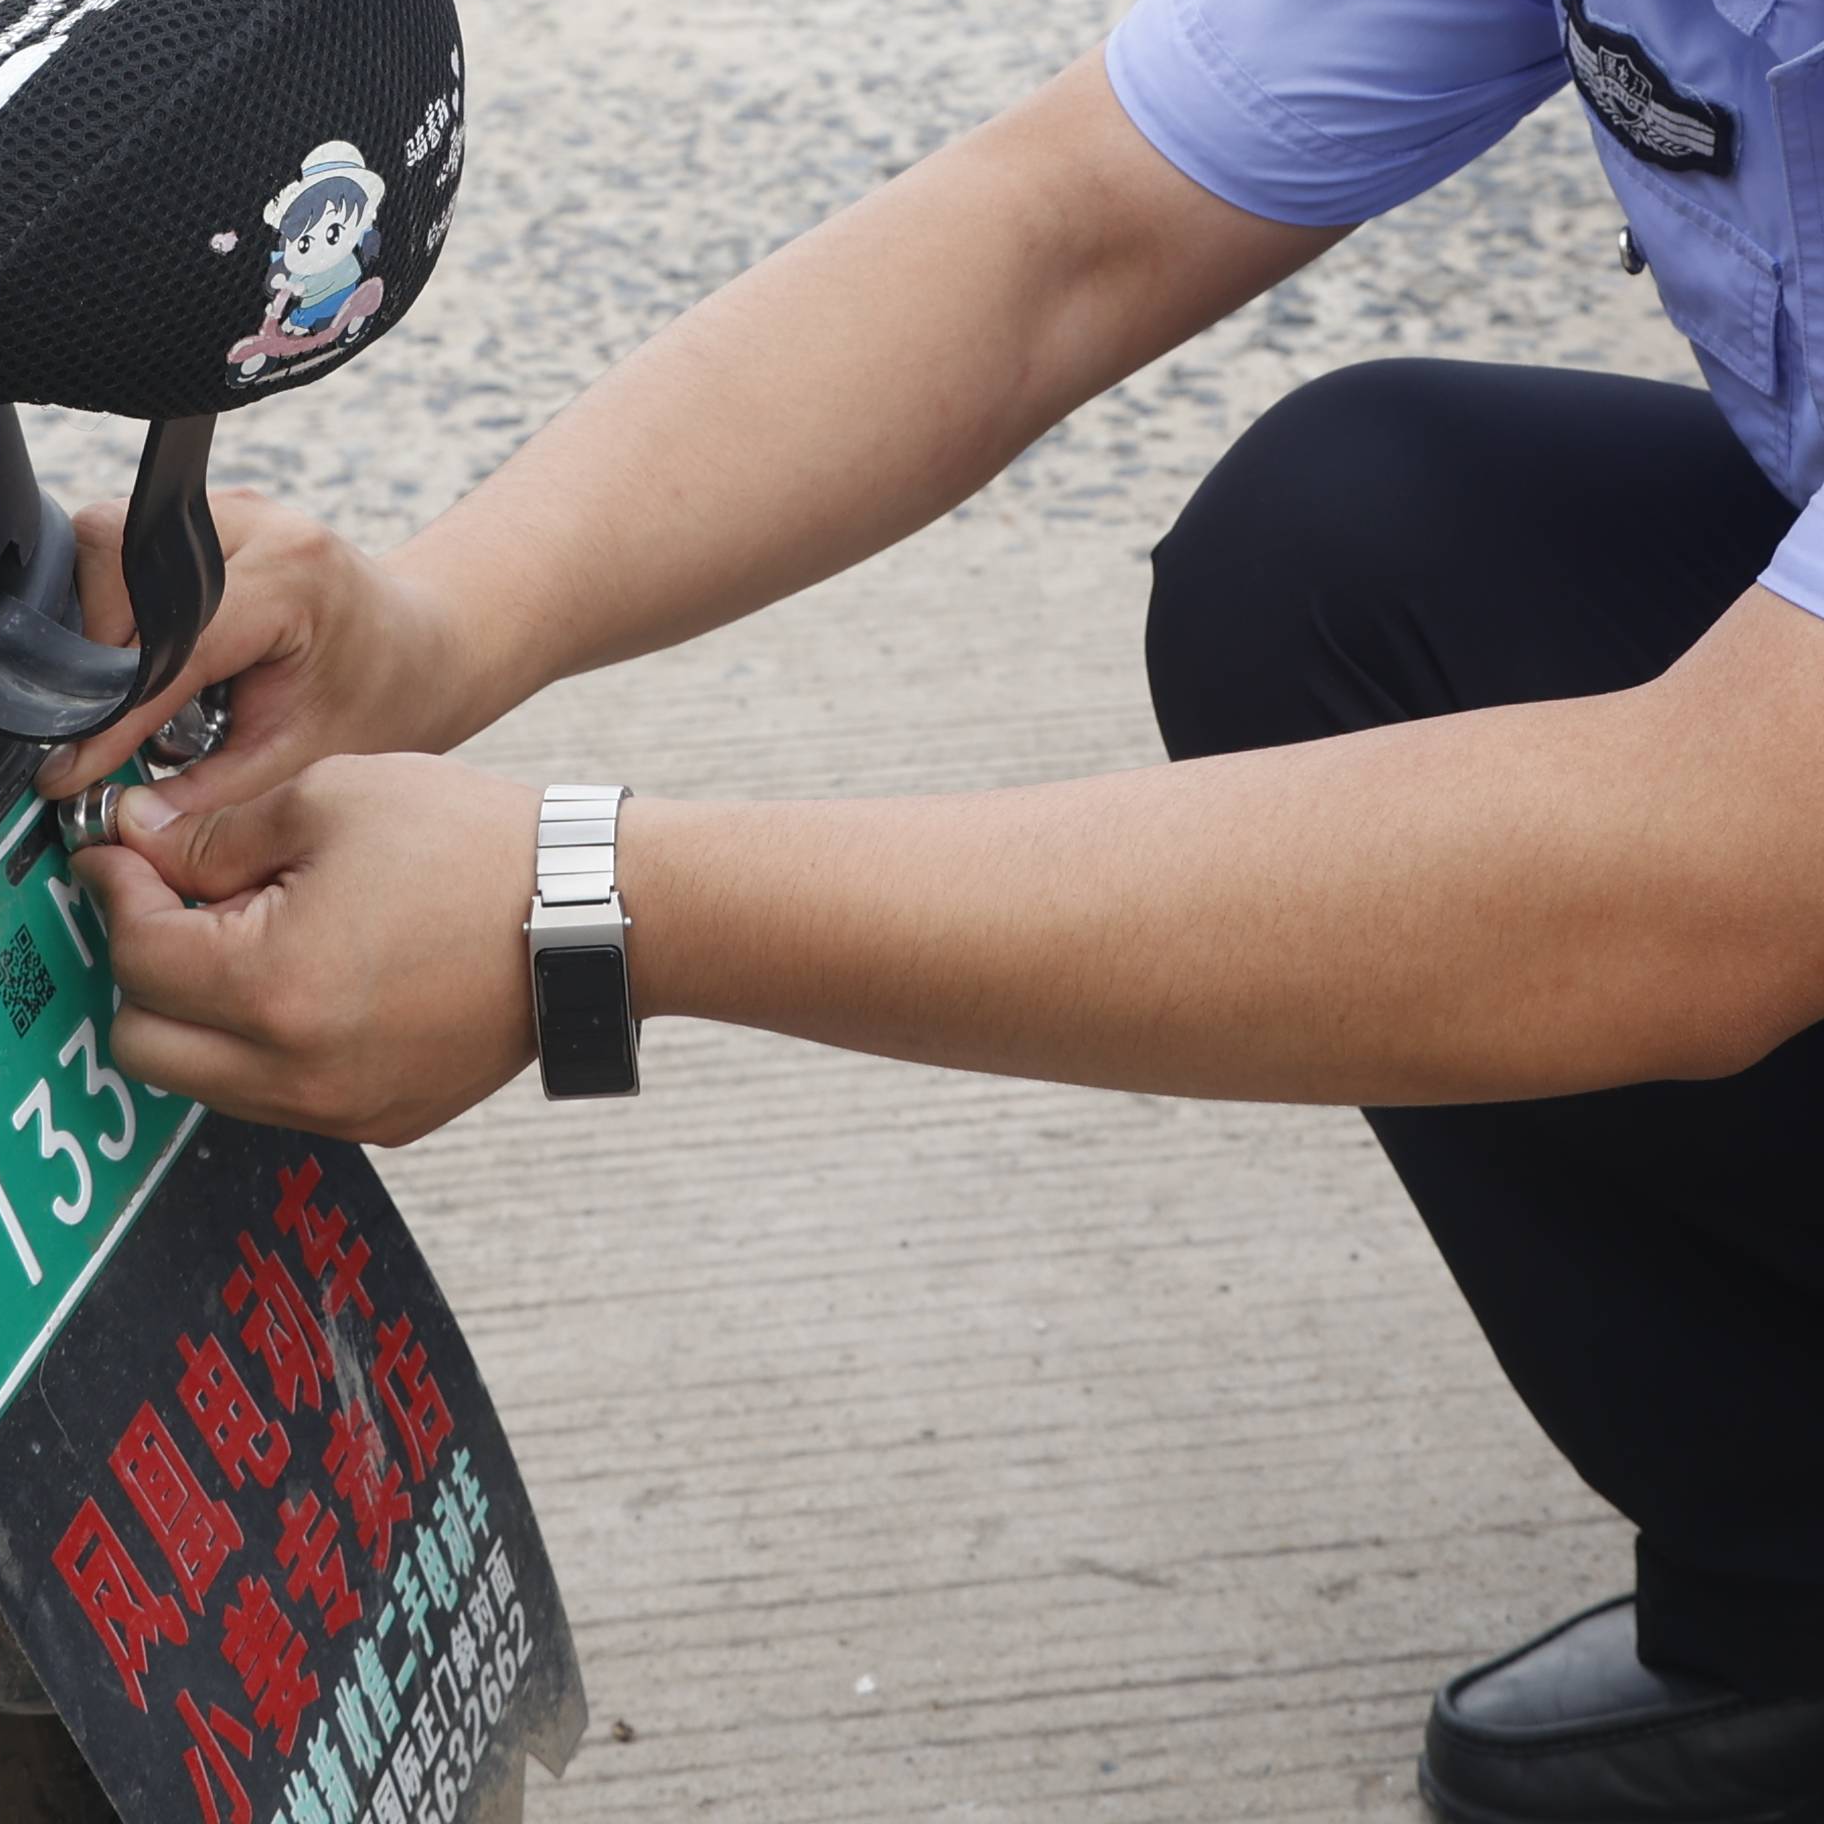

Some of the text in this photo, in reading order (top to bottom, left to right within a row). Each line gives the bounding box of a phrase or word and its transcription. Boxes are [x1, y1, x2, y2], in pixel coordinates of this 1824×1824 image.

[51, 1155, 375, 1713] 凤凰电动车
[175, 1312, 455, 1824] 小姜专卖店
[360, 1536, 517, 1824] 国际正门斜对面
